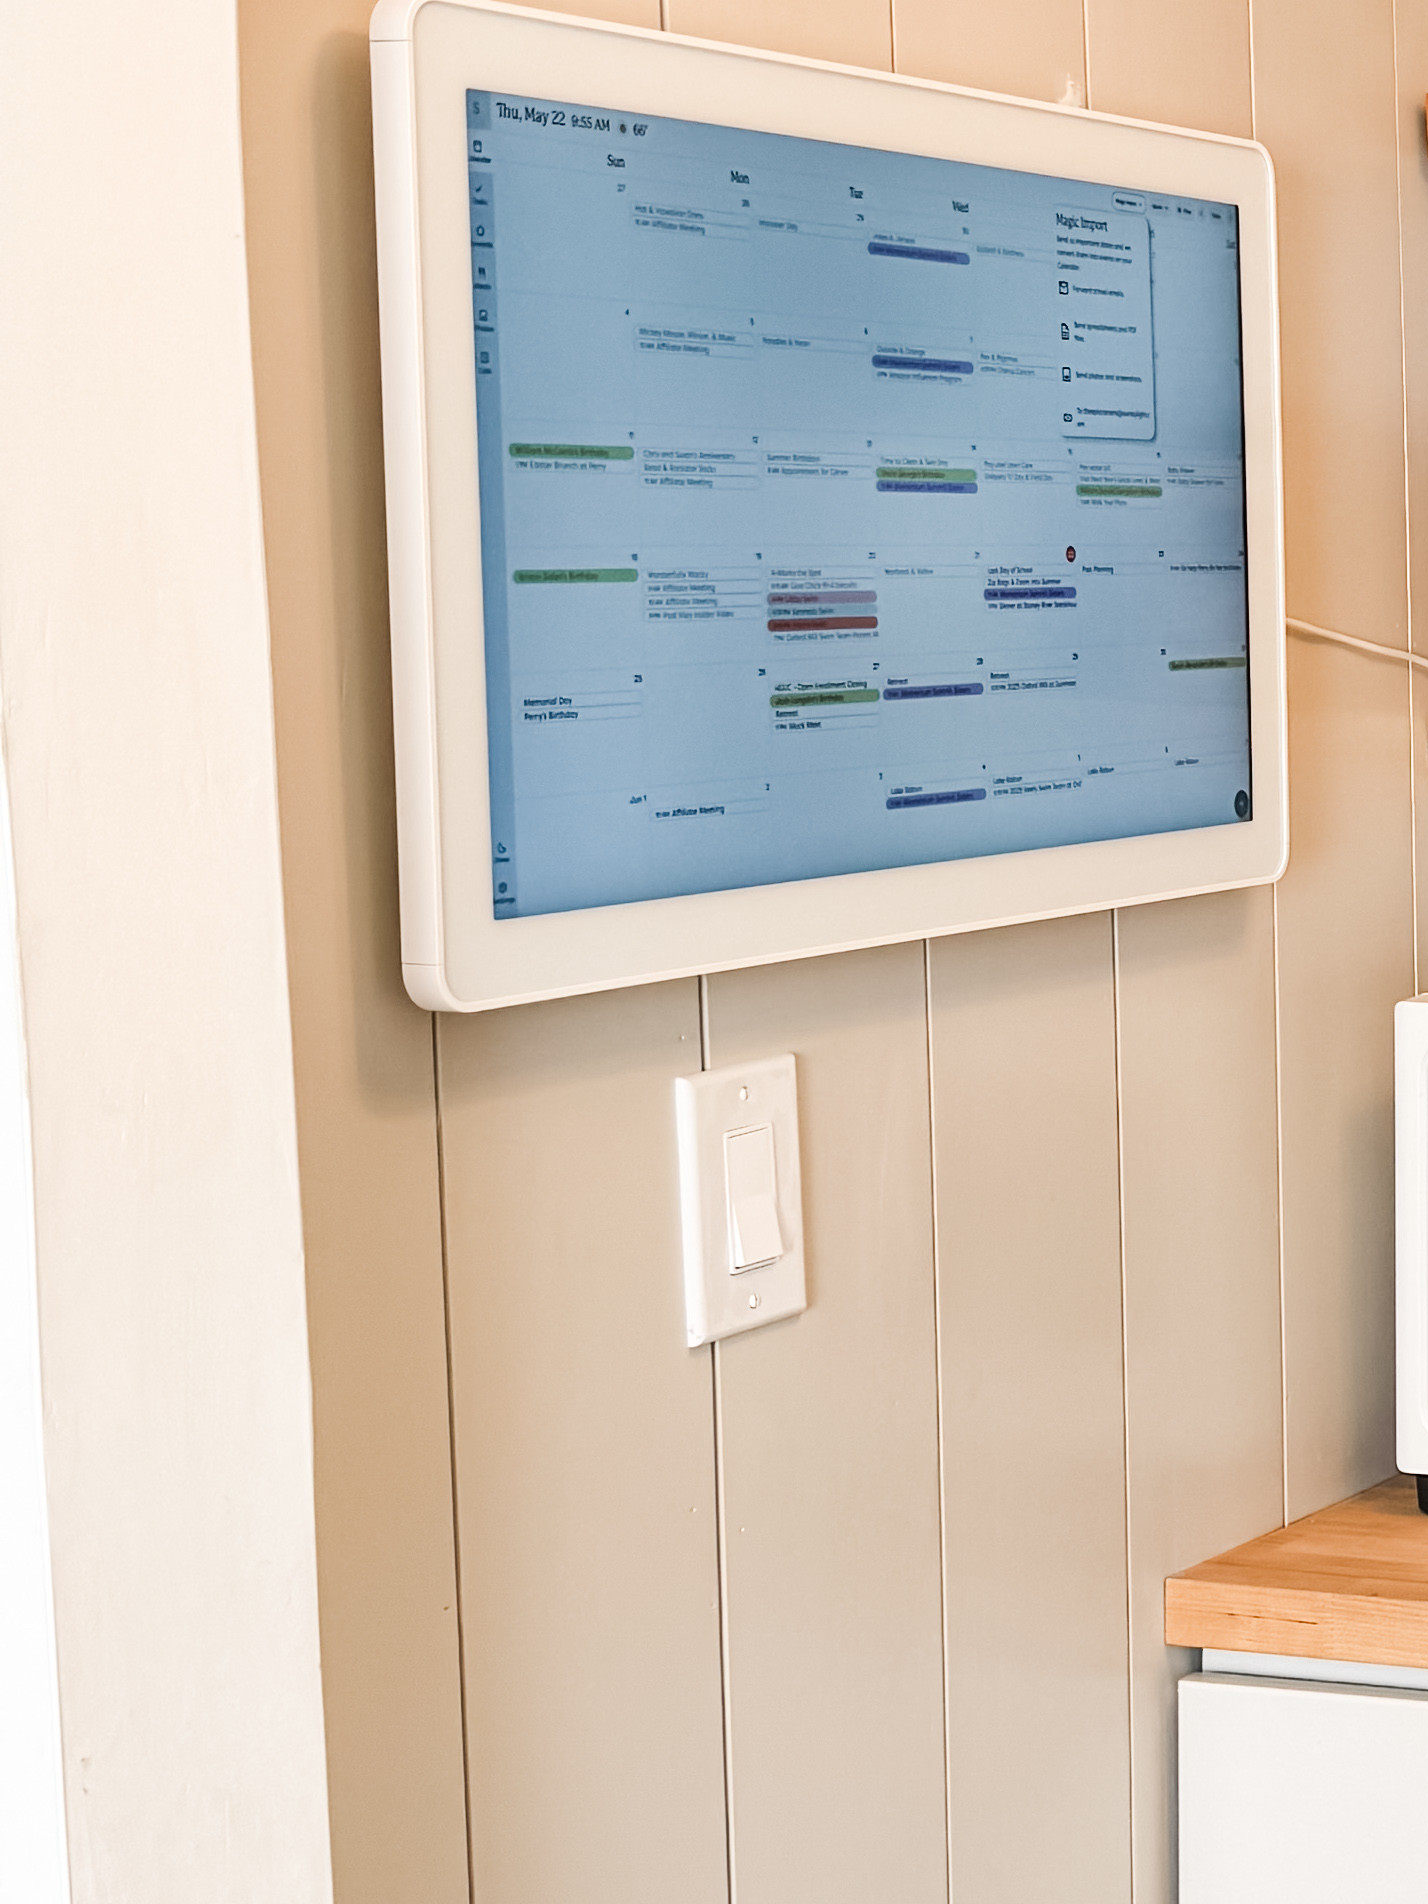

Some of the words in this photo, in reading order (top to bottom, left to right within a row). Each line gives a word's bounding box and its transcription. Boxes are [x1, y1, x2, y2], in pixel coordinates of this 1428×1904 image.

[496, 102, 523, 123] Thu,
[524, 107, 550, 127] May
[550, 110, 566, 126] 22
[594, 118, 610, 132] AM
[607, 154, 626, 168] Sun
[730, 170, 750, 184] Mon
[849, 186, 863, 199] Tue
[952, 201, 969, 213] Wed
[1056, 213, 1079, 231] Magic
[1081, 216, 1108, 232] Import
[559, 695, 573, 707] Day
